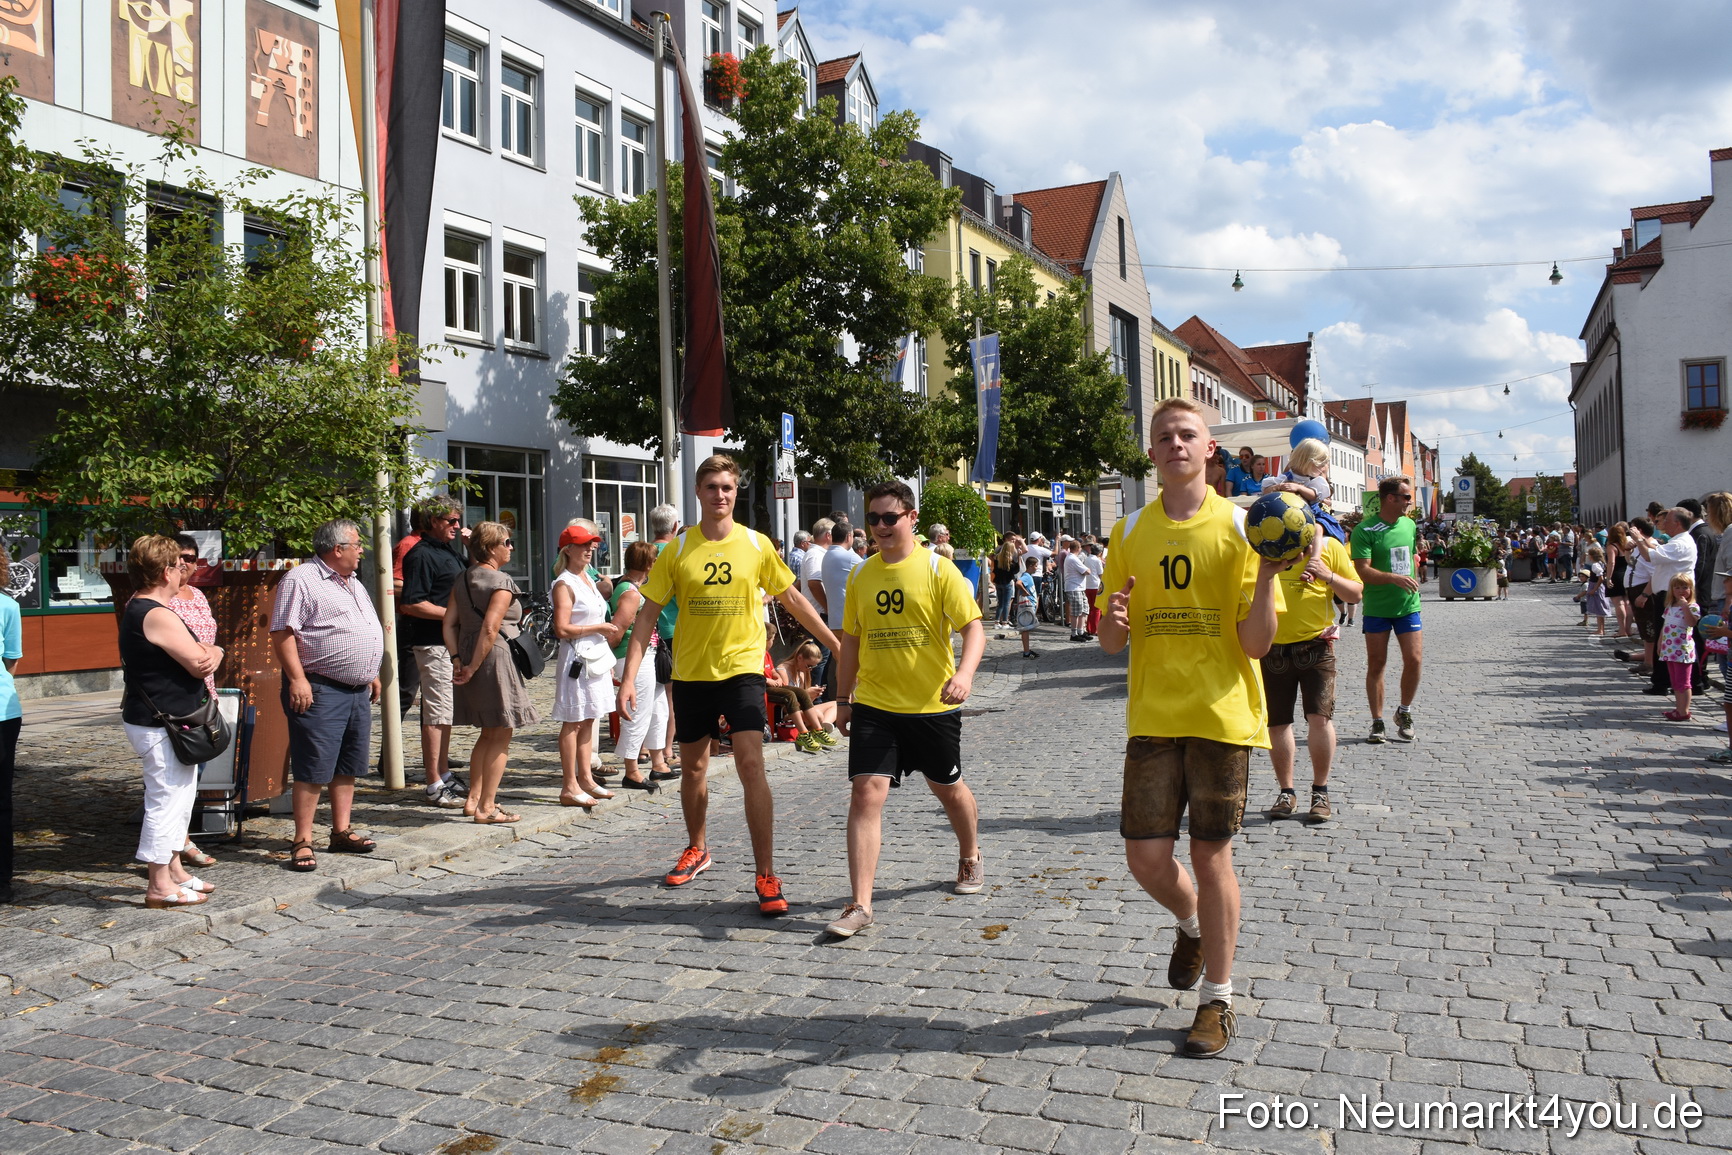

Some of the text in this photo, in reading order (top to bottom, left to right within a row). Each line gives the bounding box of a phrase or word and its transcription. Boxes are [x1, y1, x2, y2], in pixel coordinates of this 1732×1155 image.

[784, 418, 792, 445] P
[1054, 485, 1062, 502] P
[703, 561, 732, 585] 23
[1159, 554, 1192, 590] 10
[875, 588, 905, 615] 99
